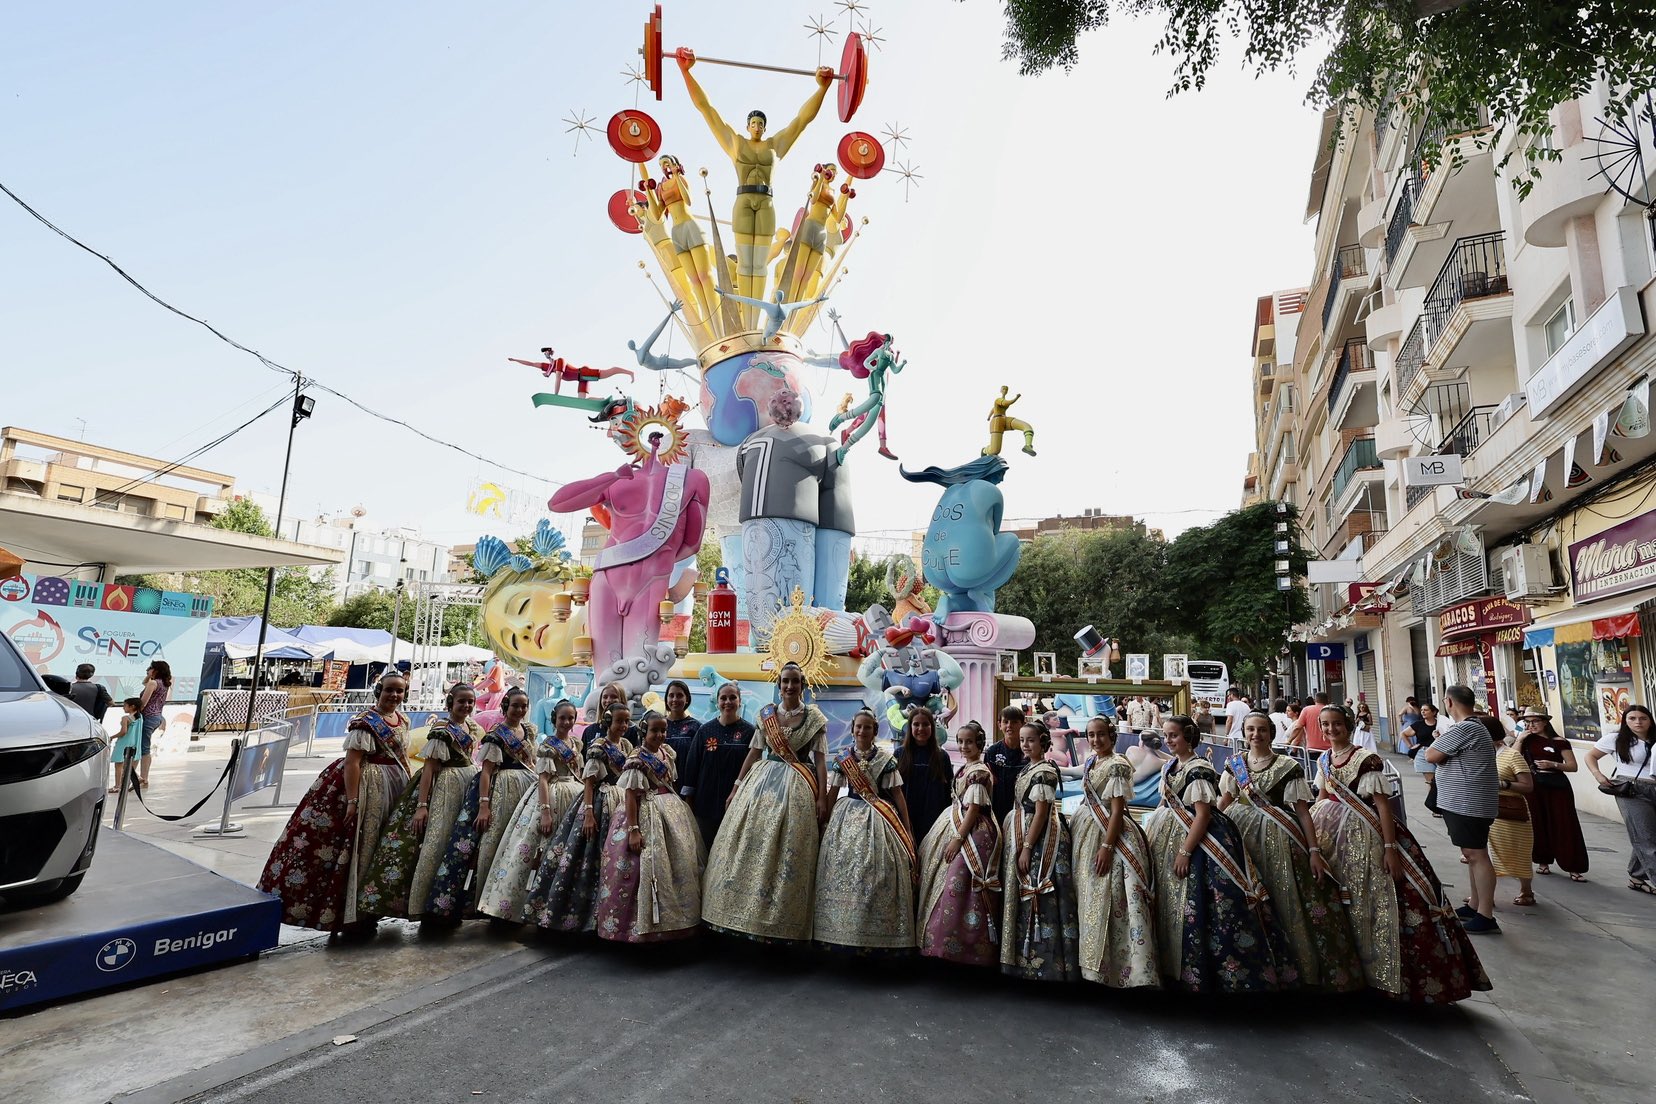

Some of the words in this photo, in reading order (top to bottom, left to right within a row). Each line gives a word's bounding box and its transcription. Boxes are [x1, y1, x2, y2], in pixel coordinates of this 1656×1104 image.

[1420, 461, 1445, 475] MB
[934, 529, 947, 542] de
[1575, 538, 1638, 584] Mara
[709, 619, 731, 627] TEAM
[103, 630, 136, 638] FOGUERA
[153, 927, 238, 956] Benigar
